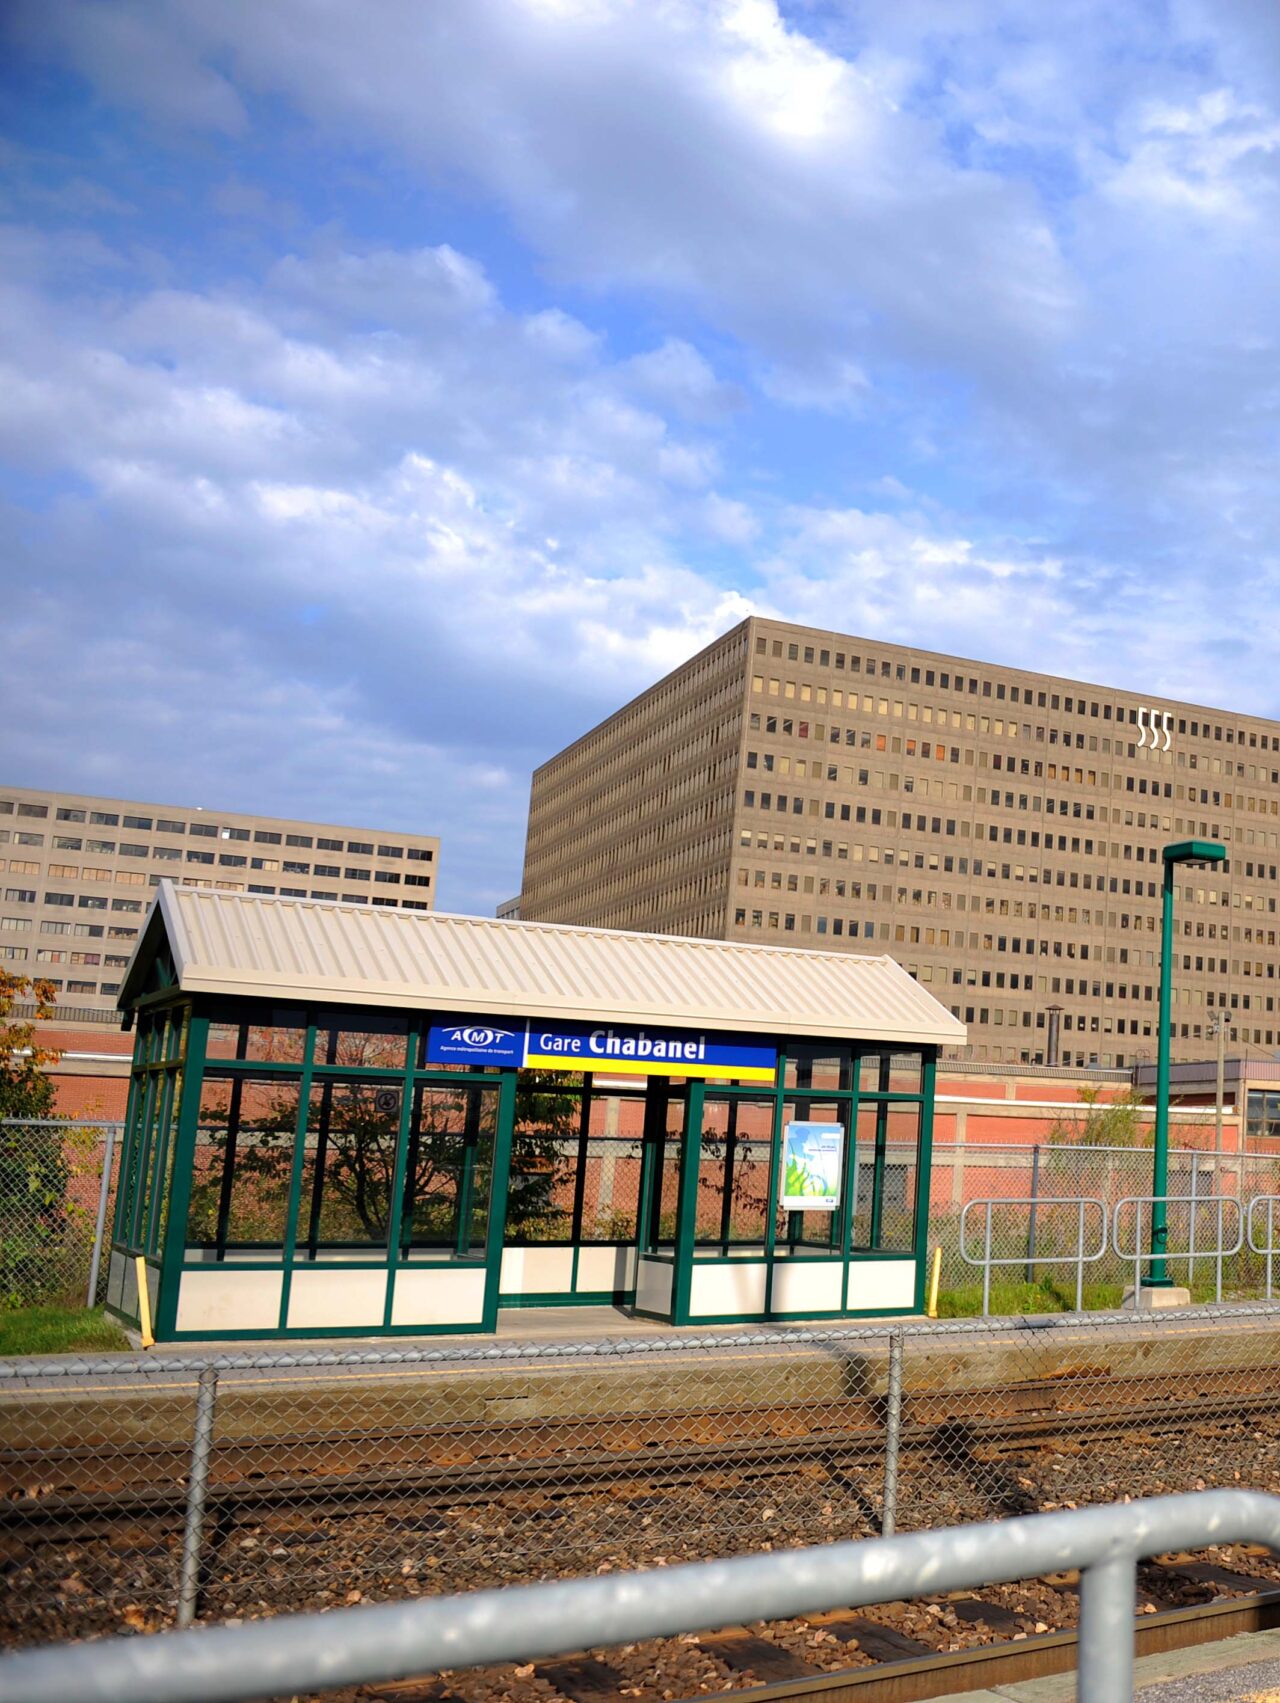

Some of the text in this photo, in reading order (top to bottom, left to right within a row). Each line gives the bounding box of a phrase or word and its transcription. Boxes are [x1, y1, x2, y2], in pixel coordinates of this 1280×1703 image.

[451, 1030, 504, 1044] AMT
[539, 1030, 706, 1060] Gare Chabanel
